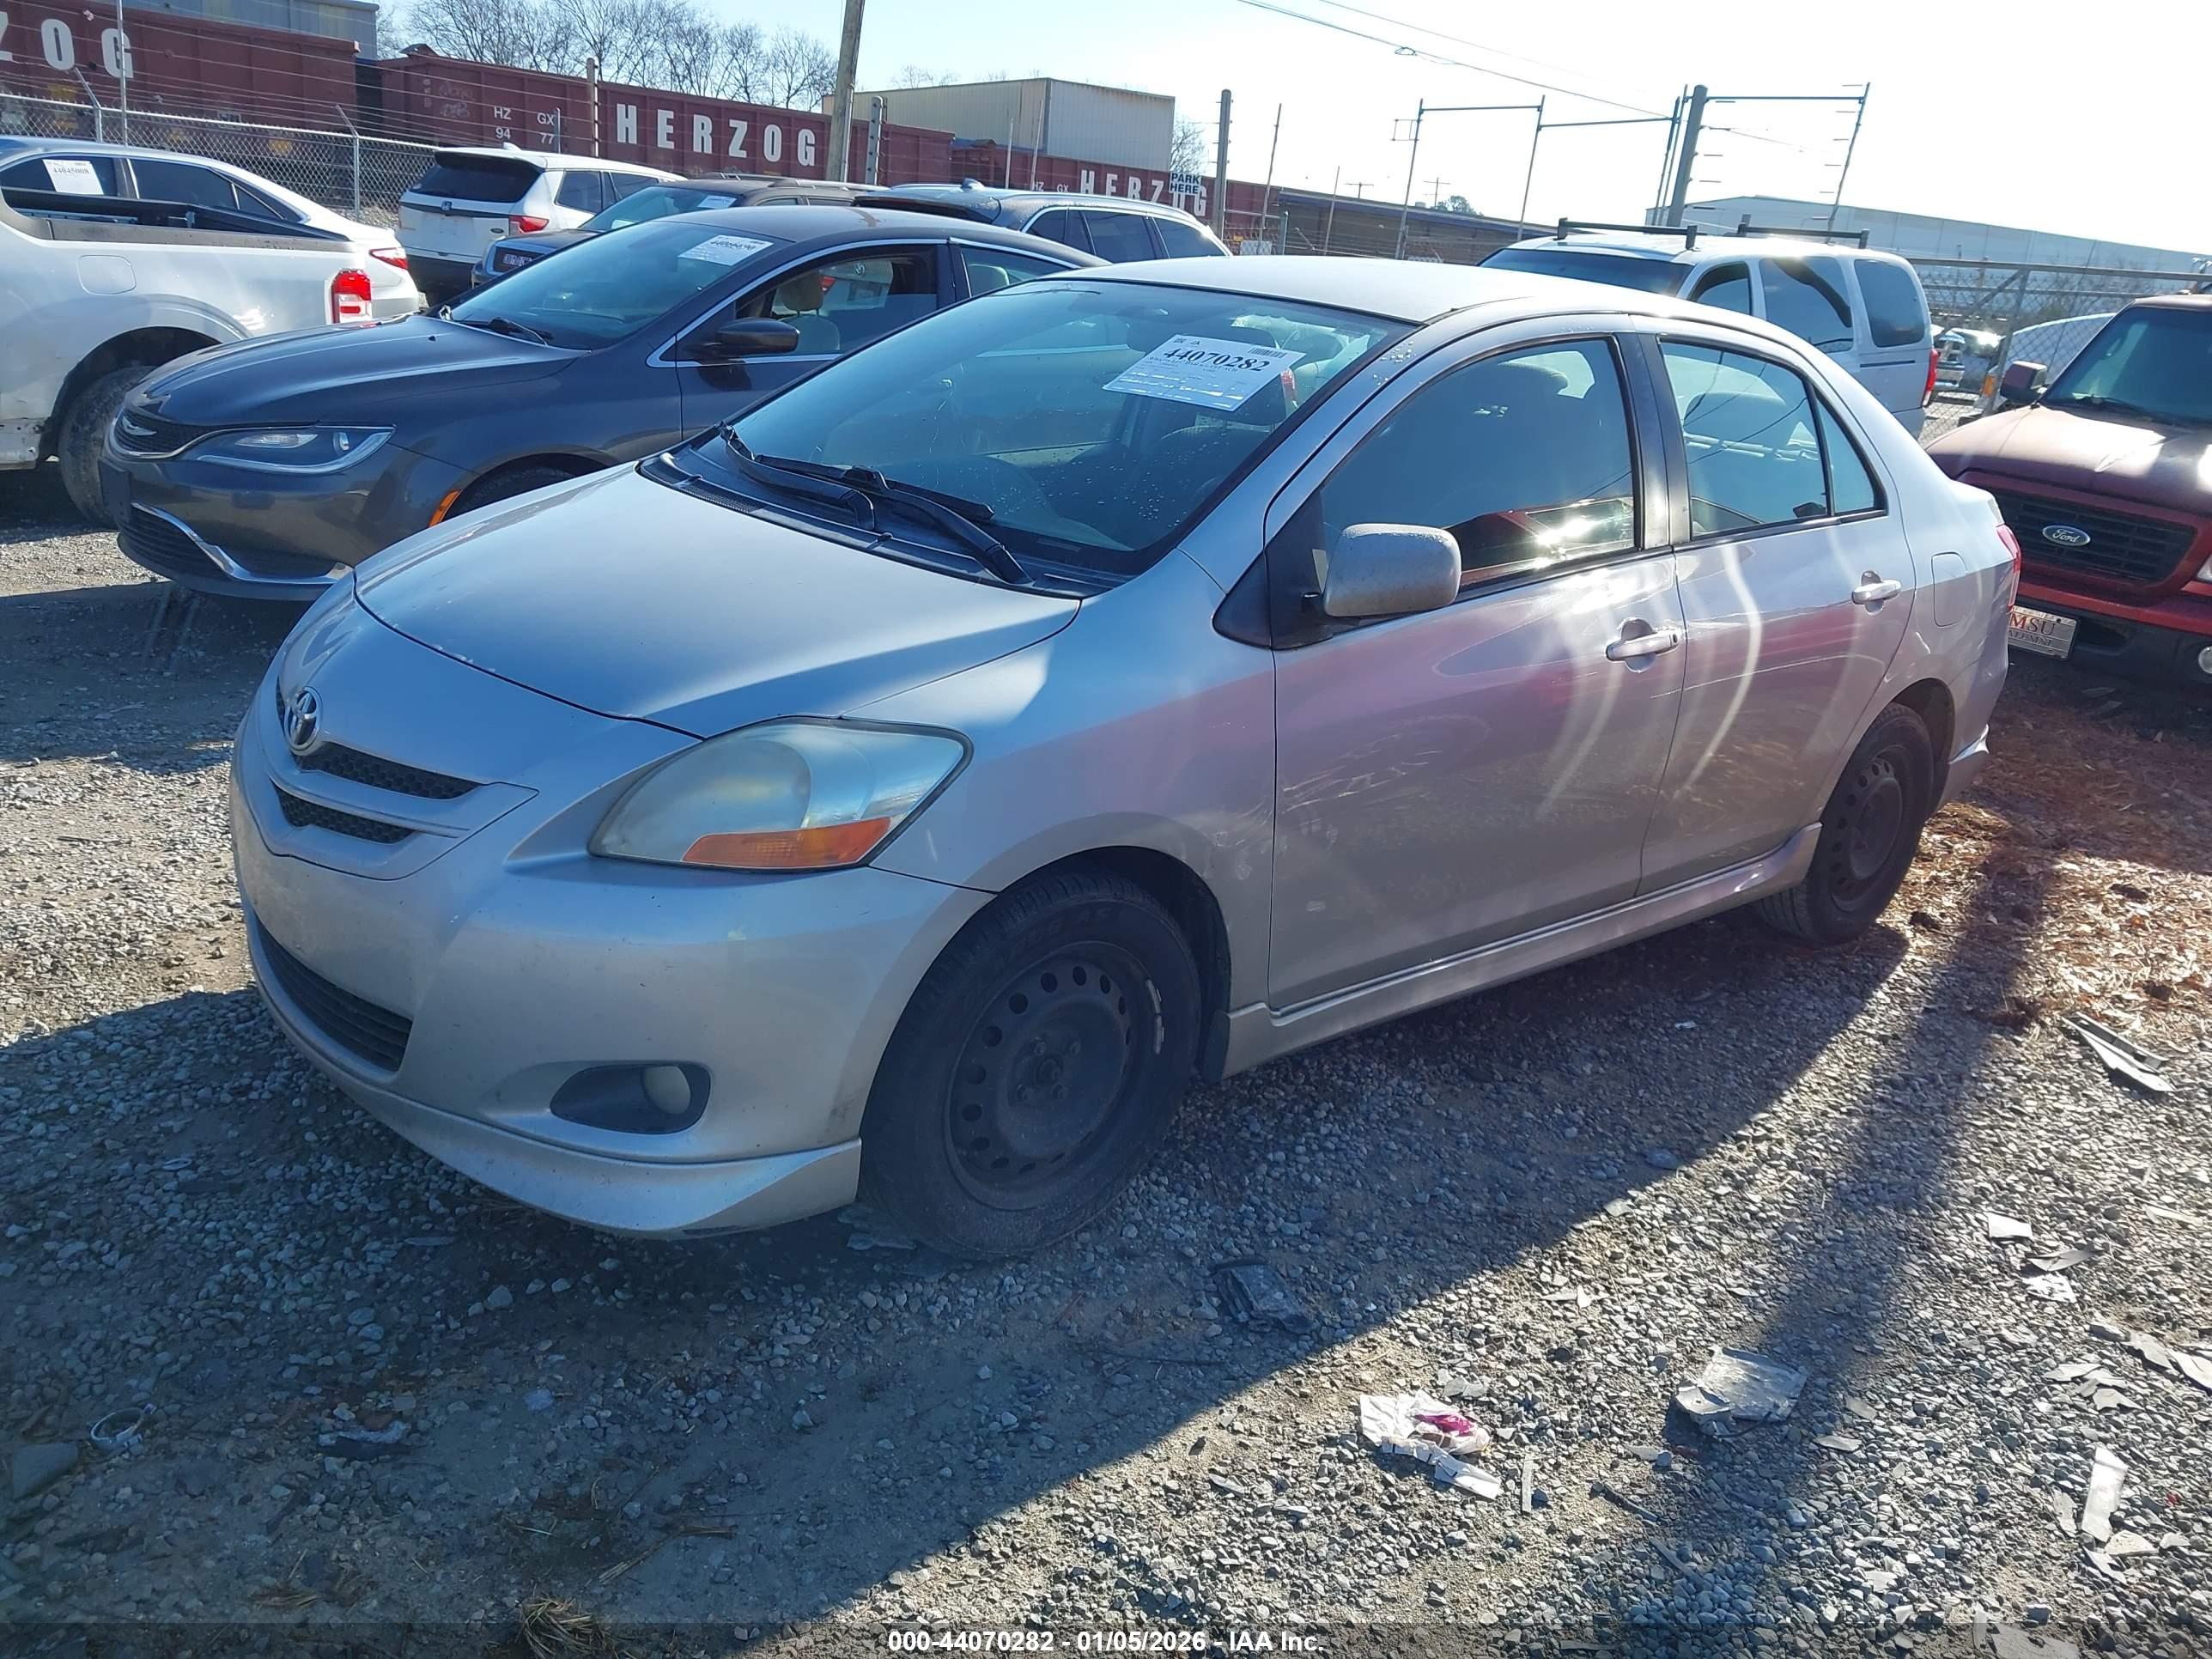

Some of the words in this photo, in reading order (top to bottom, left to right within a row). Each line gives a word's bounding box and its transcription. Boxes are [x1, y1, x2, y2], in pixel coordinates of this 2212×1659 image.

[494, 106, 512, 120] HZ
[537, 112, 555, 126] GX
[495, 127, 511, 139] 94
[539, 131, 556, 145] 77
[616, 102, 816, 167] HERZOG
[1170, 182, 1200, 194] HERE
[1171, 173, 1200, 185] PARK
[1164, 348, 1271, 372] 44070282
[2052, 528, 2081, 543] Ford
[2009, 612, 2056, 635] MSU
